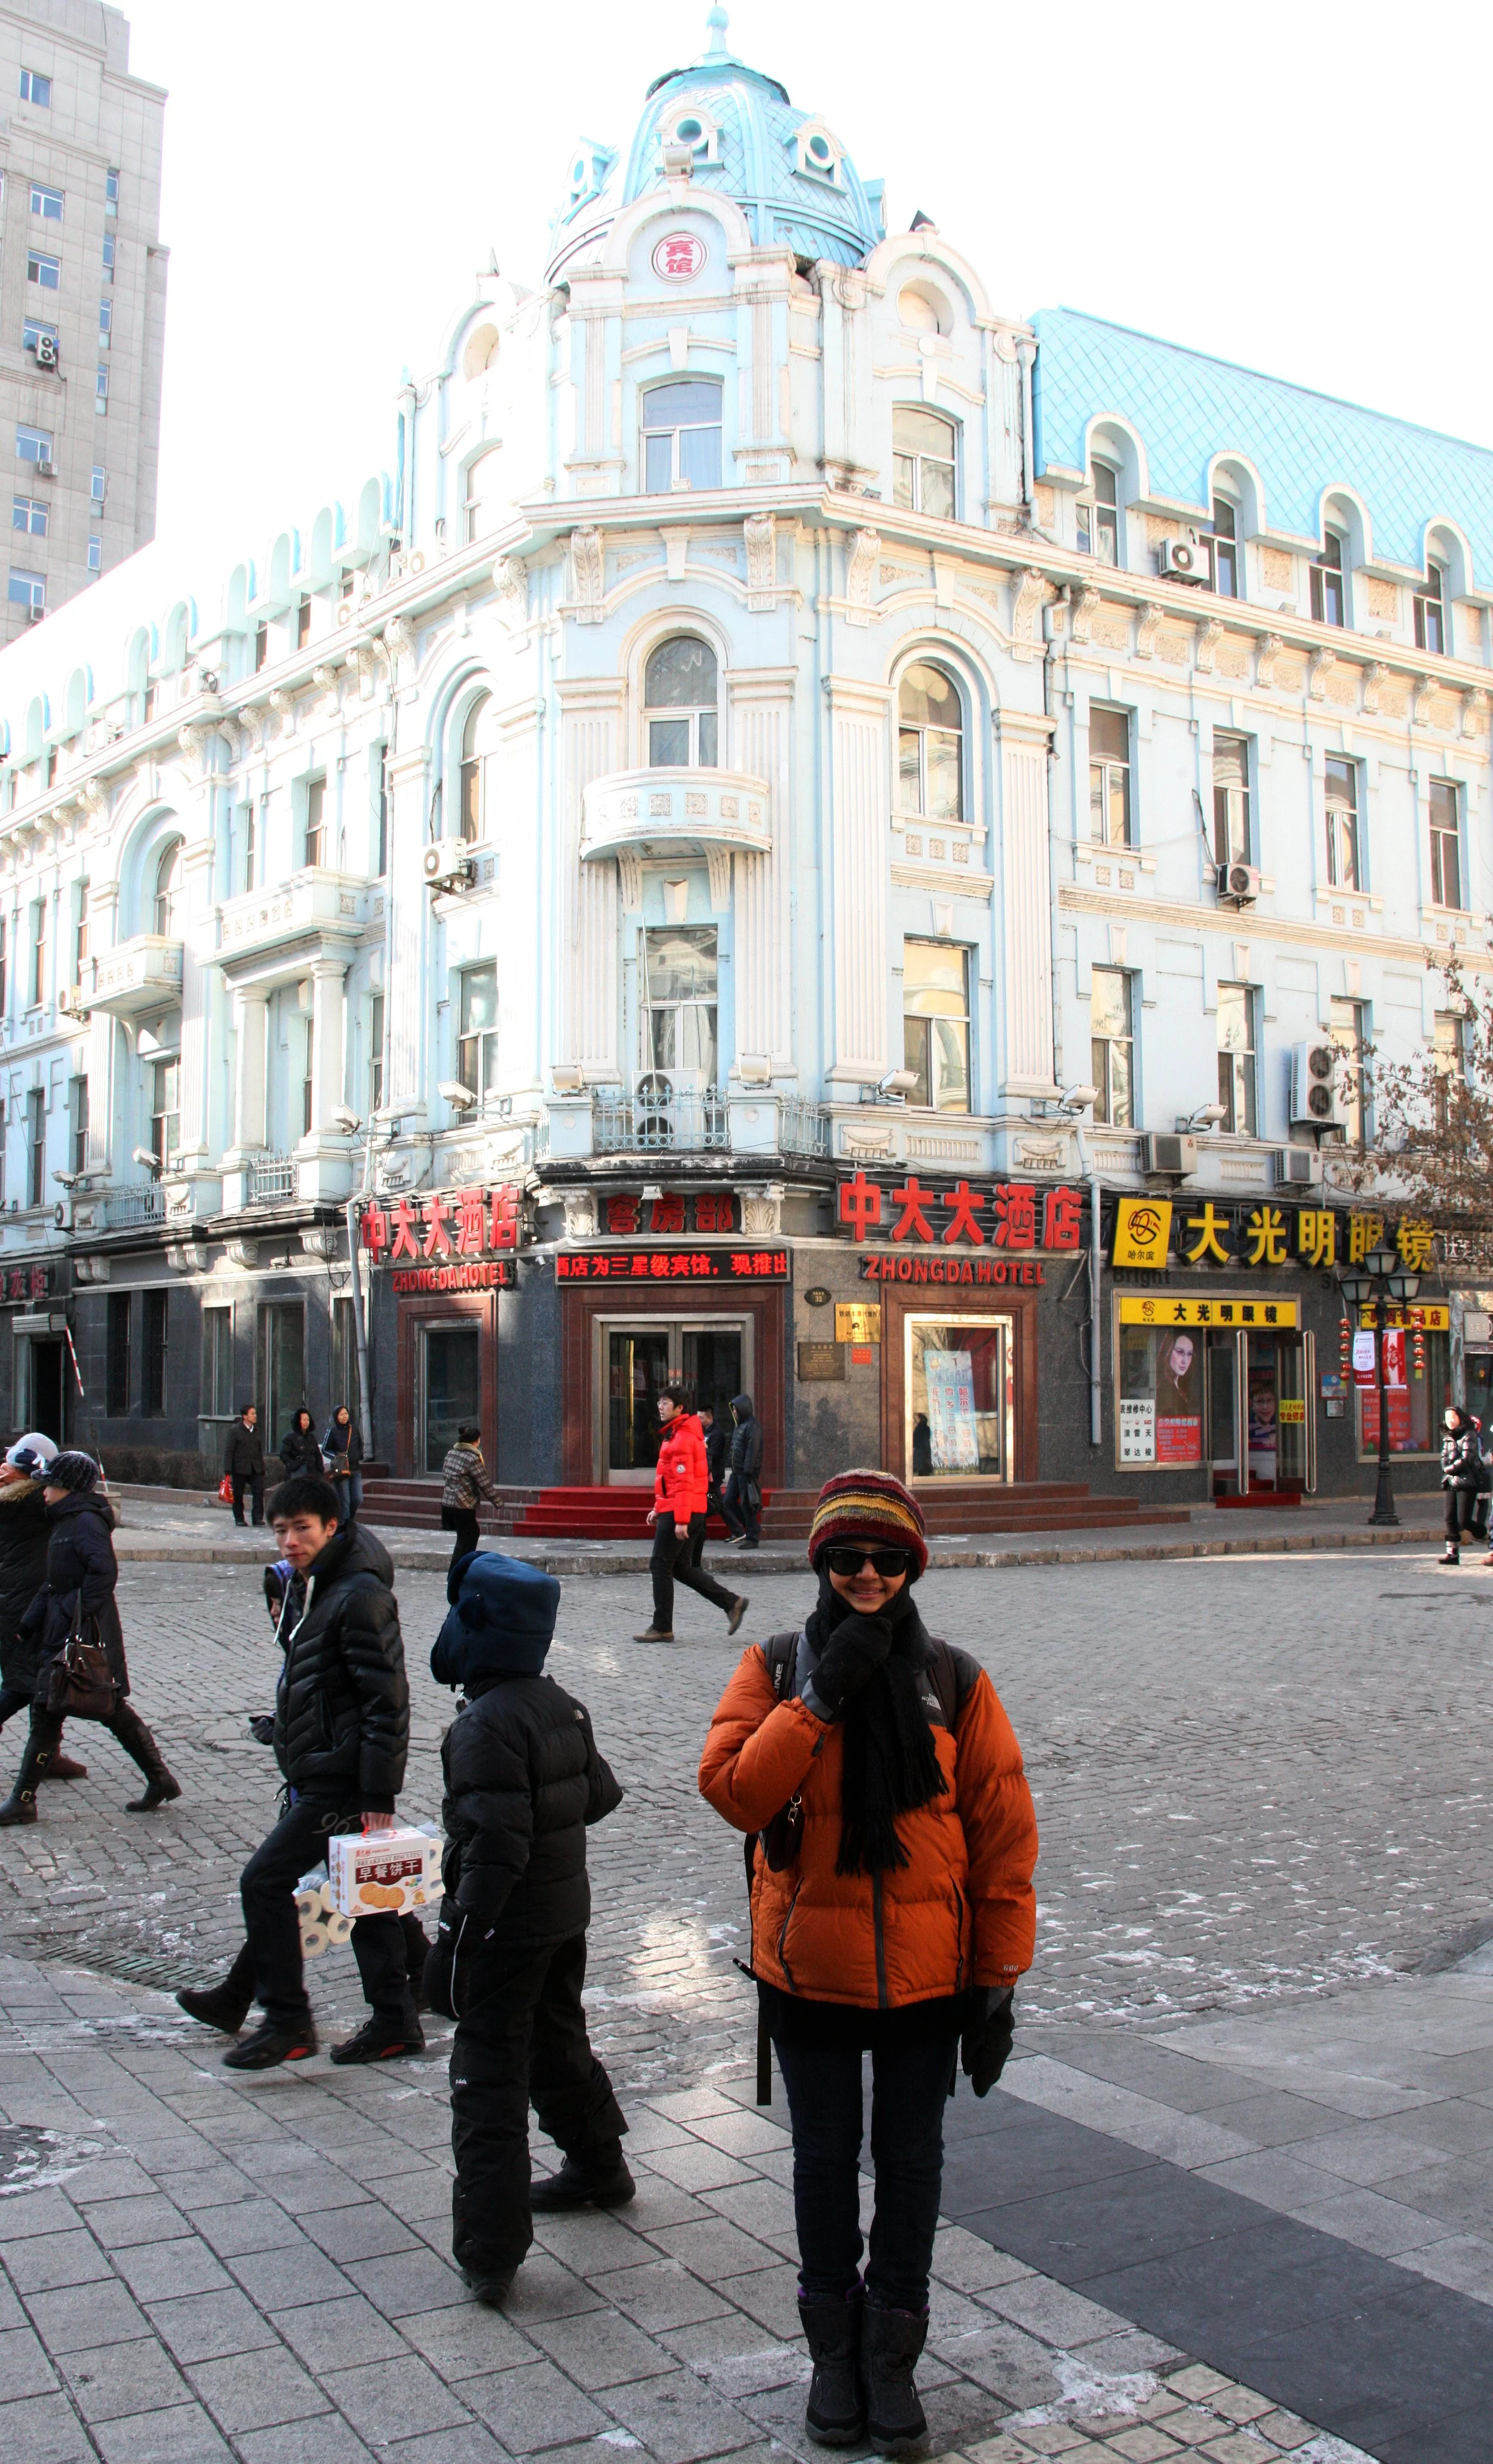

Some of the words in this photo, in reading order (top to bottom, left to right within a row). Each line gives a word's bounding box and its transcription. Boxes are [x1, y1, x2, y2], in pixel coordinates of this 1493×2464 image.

[666, 240, 694, 274] 宾馆
[362, 1182, 521, 1264] 中大大酒店
[607, 1192, 733, 1233] 客房部
[838, 1172, 1082, 1249] 中大大酒店
[1185, 1202, 1434, 1272] 大光明眼镜
[1128, 1250, 1154, 1261] 哈尔滨
[0, 1265, 49, 1299] 衣柜
[459, 1261, 508, 1289] HOTEL
[978, 1260, 1047, 1285] HOTEL
[1173, 1303, 1277, 1323] 大光明眼镜
[1387, 1347, 1399, 1364] 福
[1120, 1404, 1153, 1414] 表维修中心
[359, 1860, 419, 1881] 早餐饼干
